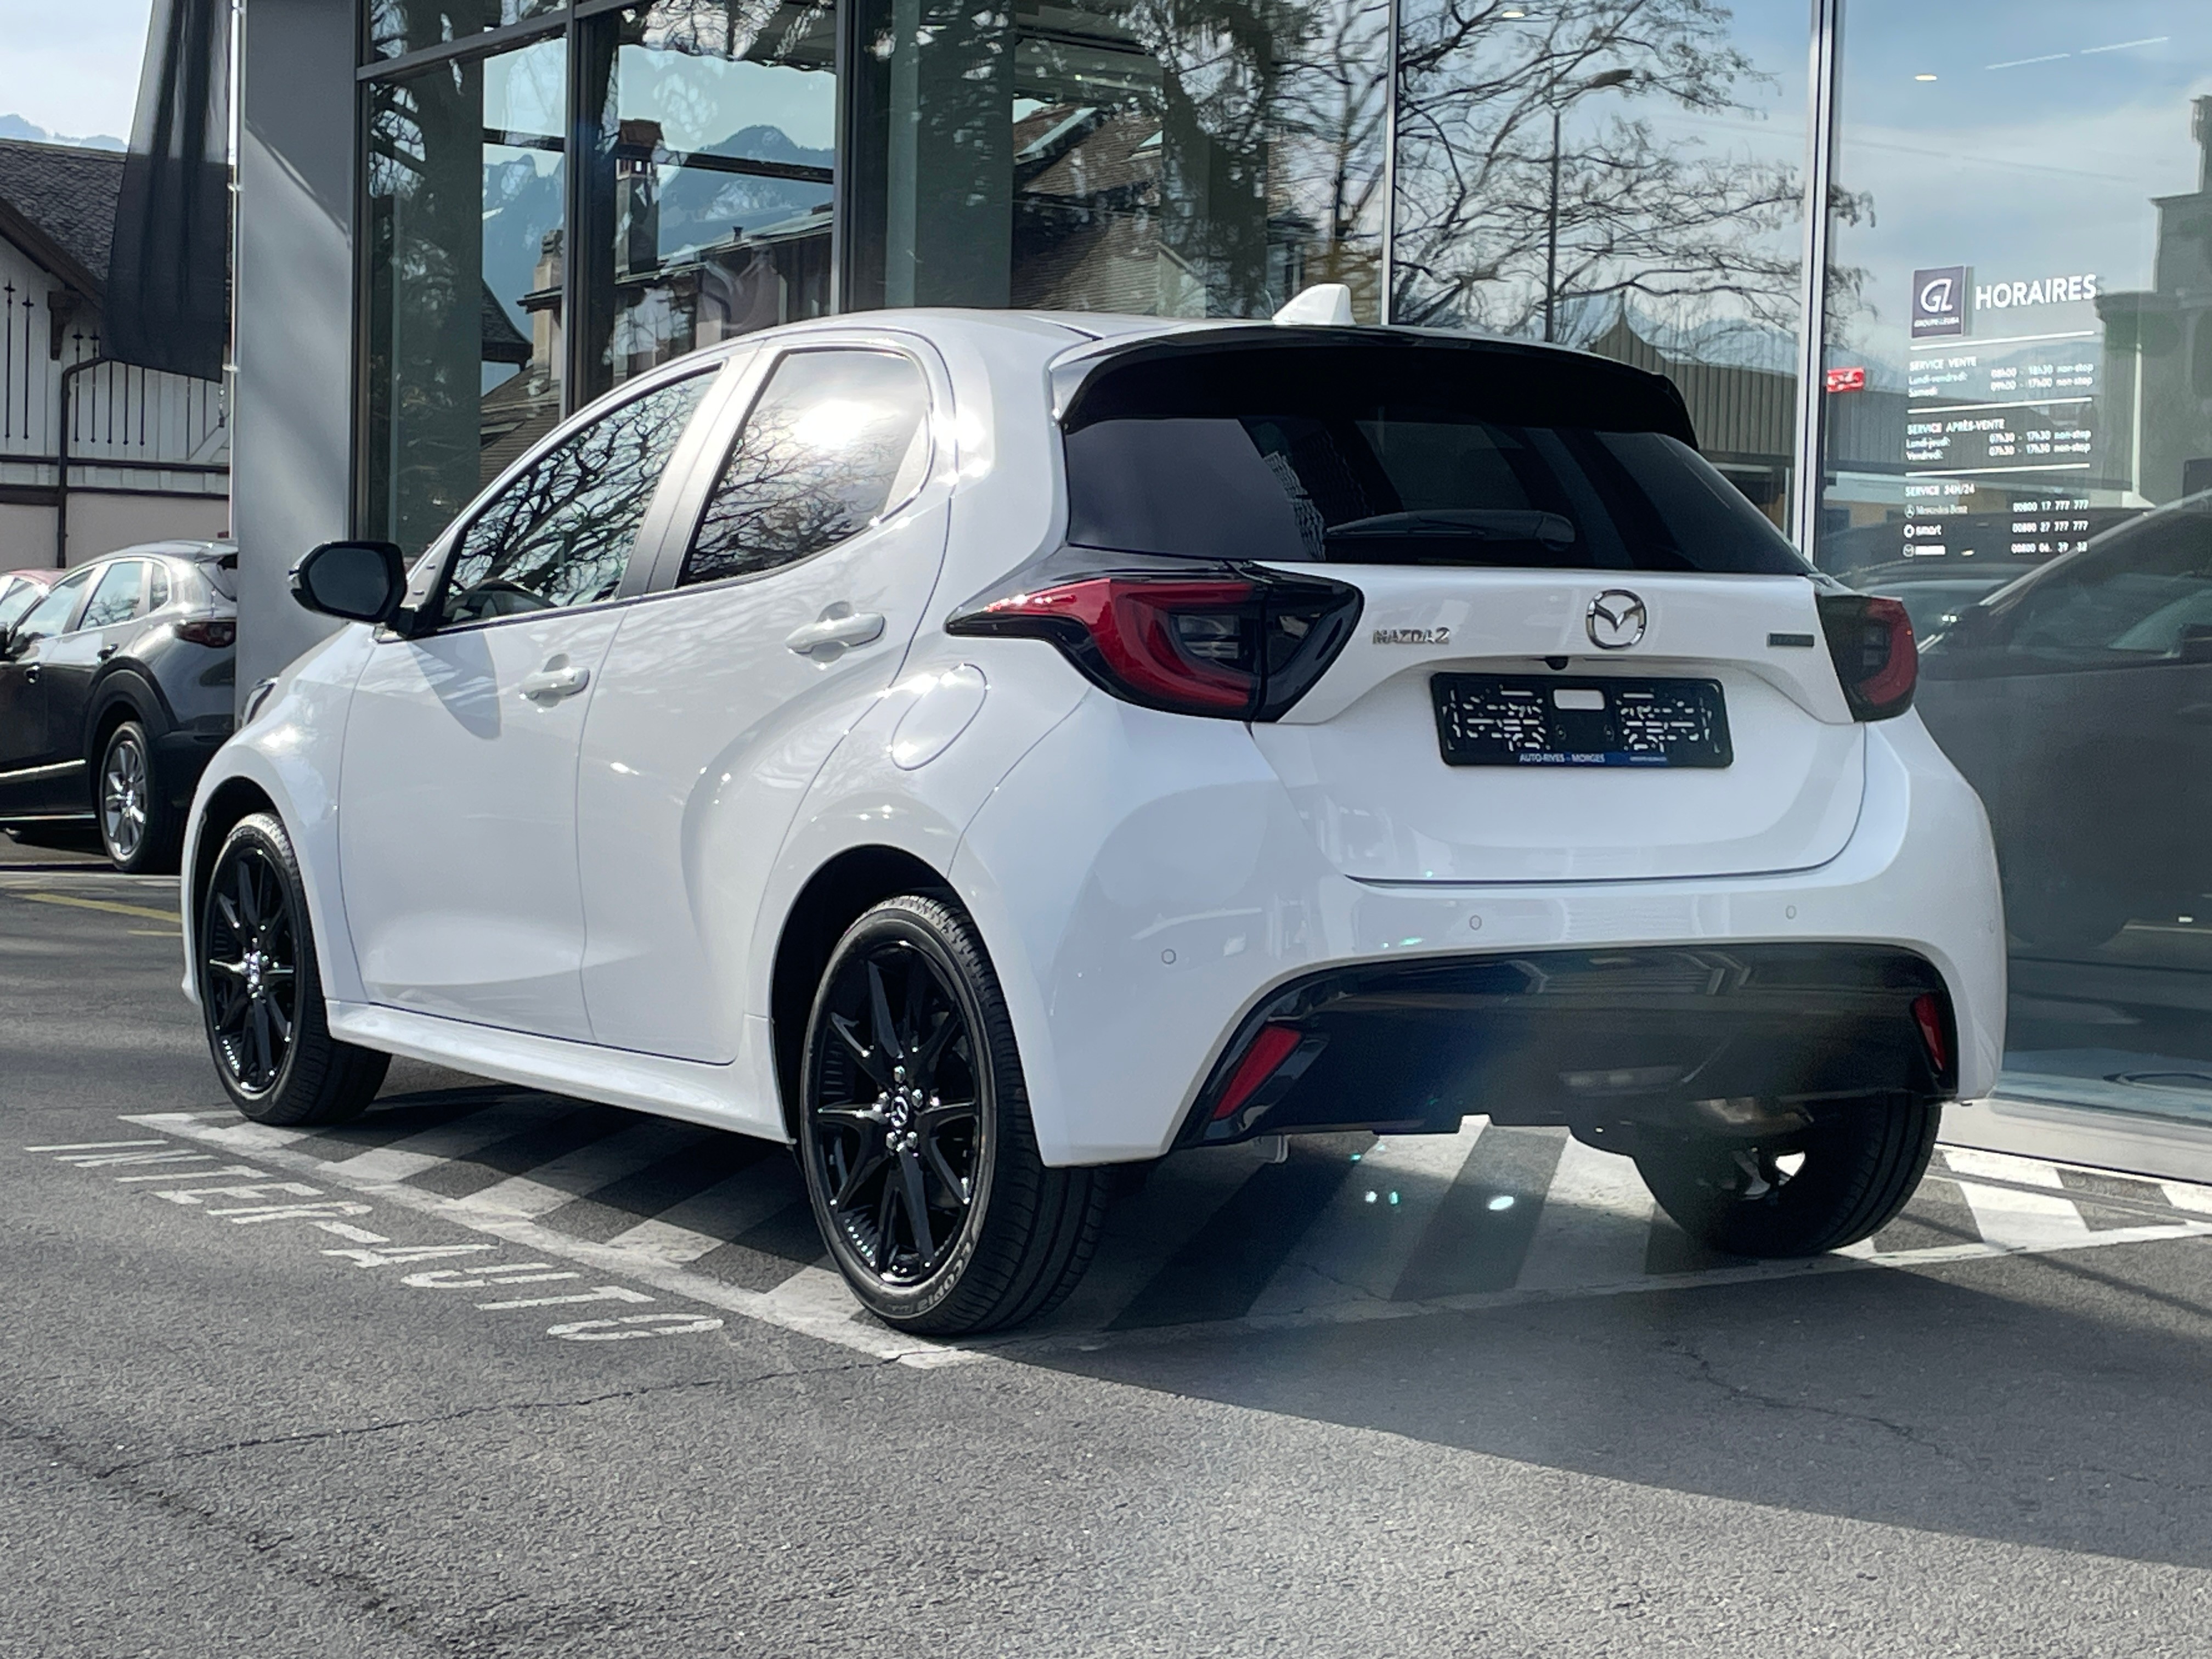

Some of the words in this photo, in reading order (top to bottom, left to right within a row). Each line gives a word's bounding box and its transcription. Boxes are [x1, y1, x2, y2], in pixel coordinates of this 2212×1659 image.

[1921, 278, 1953, 313] GL
[1976, 274, 2097, 311] HORAIRES
[1910, 359, 1944, 371] SERVICE
[1948, 356, 1977, 368] VENTE
[1907, 422, 1942, 435] SERVICE
[1946, 418, 2005, 433] APRÈS-VENTE
[1905, 486, 1940, 497] SERVICE
[2041, 500, 2051, 511] 17
[2055, 500, 2070, 511] 777
[2073, 499, 2089, 510] 777
[1916, 524, 1942, 537] smart
[2073, 520, 2089, 531] 777
[1571, 753, 1605, 763] MORGES
